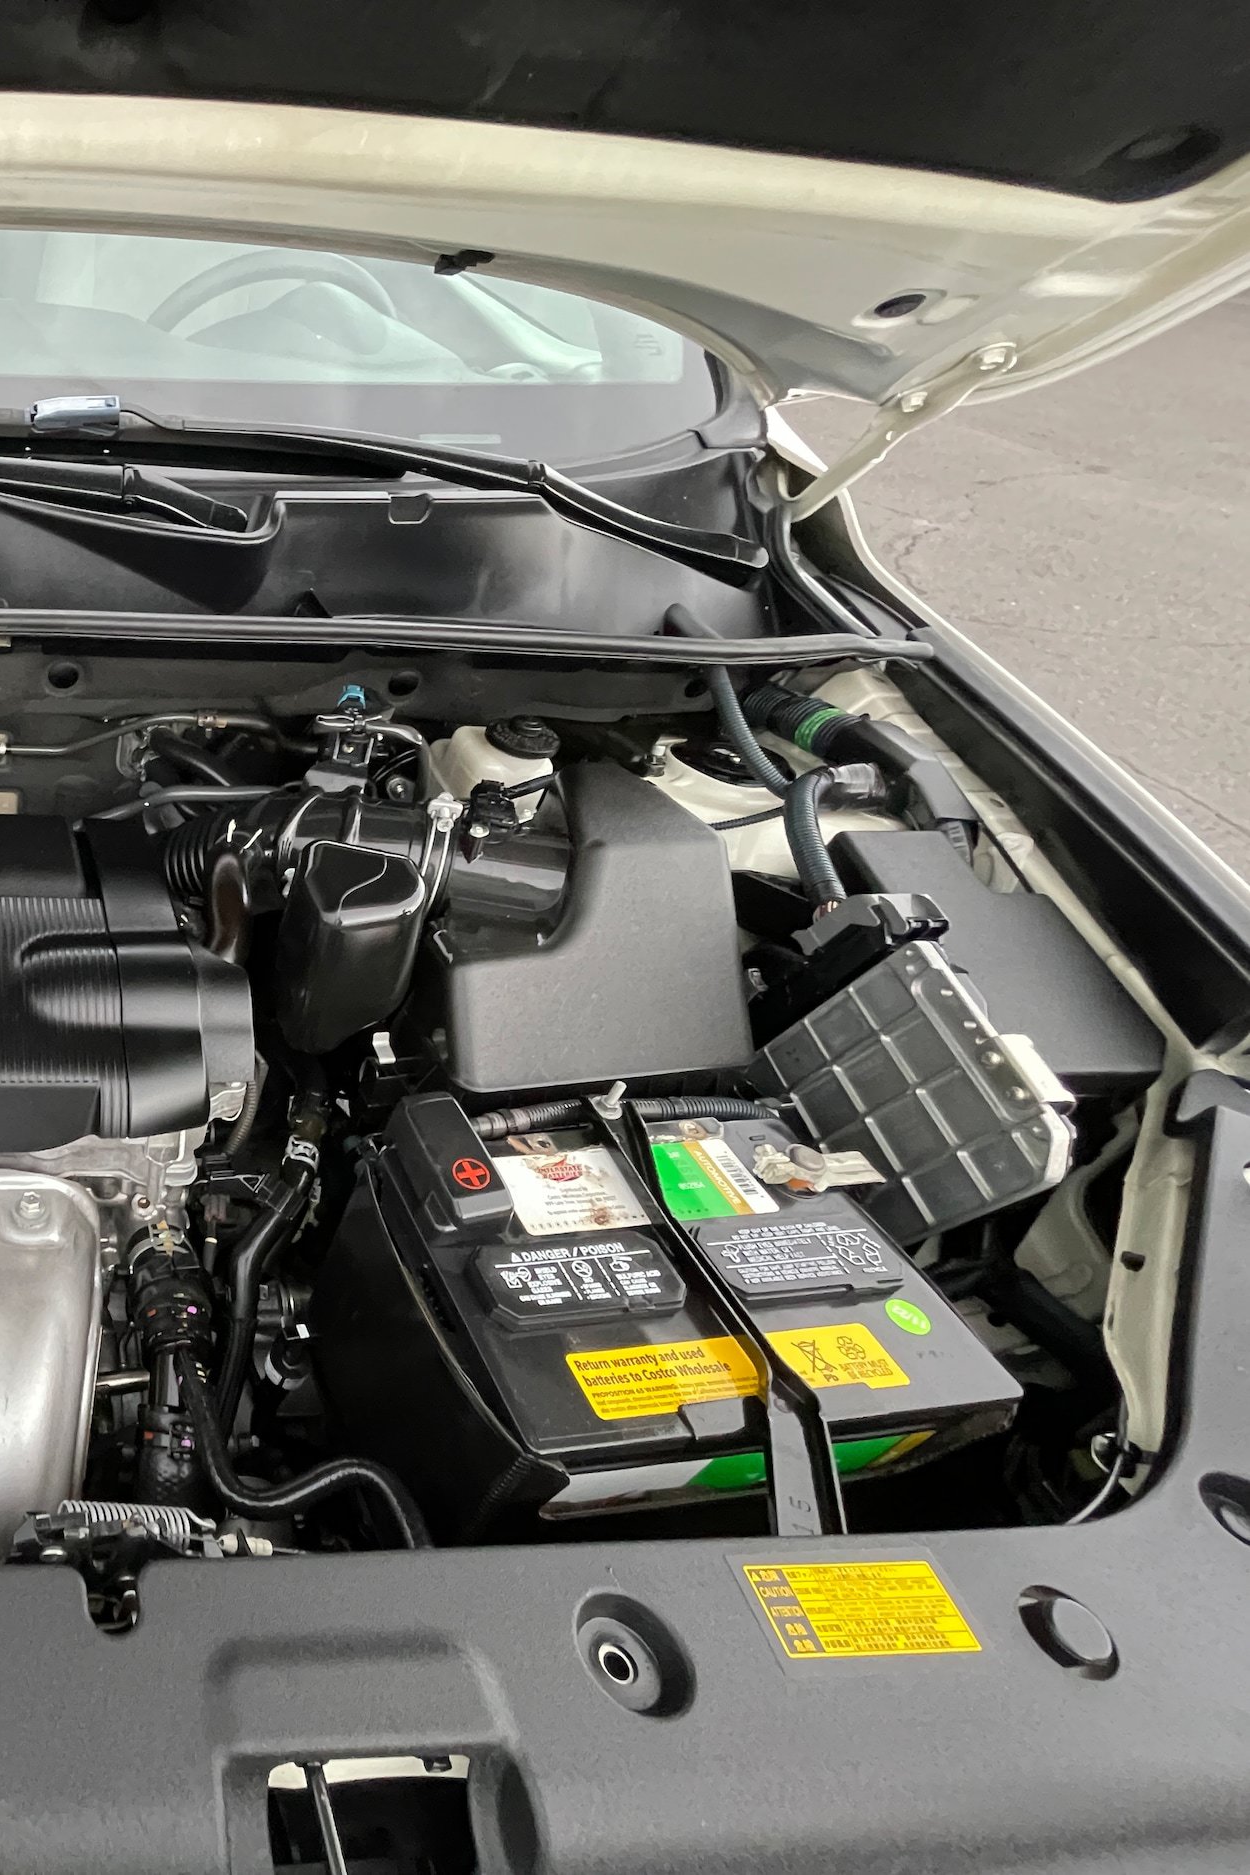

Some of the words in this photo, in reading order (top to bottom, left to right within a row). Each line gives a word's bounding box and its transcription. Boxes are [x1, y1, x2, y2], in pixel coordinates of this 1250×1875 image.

[538, 1164, 583, 1173] INTERSTATE
[543, 1171, 583, 1179] BATTERIES
[694, 1150, 741, 1204] AUTOMOTIVE
[521, 1248, 571, 1262] DANGER
[580, 1242, 624, 1256] POISON
[573, 1359, 611, 1372] Return
[611, 1354, 659, 1368] warranty
[659, 1349, 679, 1362] and
[681, 1346, 704, 1360] used
[838, 1361, 868, 1372] BATTERY
[867, 1359, 890, 1368] MUST
[583, 1371, 630, 1387] batteries
[630, 1371, 642, 1382] to
[643, 1366, 678, 1380] Costco
[677, 1361, 731, 1377] Wholesale
[823, 1373, 840, 1382] Pb
[860, 1368, 894, 1378] RECYCLED
[591, 1388, 635, 1399] PROPOSITION
[759, 1586, 796, 1598] CAUTION
[770, 1605, 806, 1617] ATTENTION
